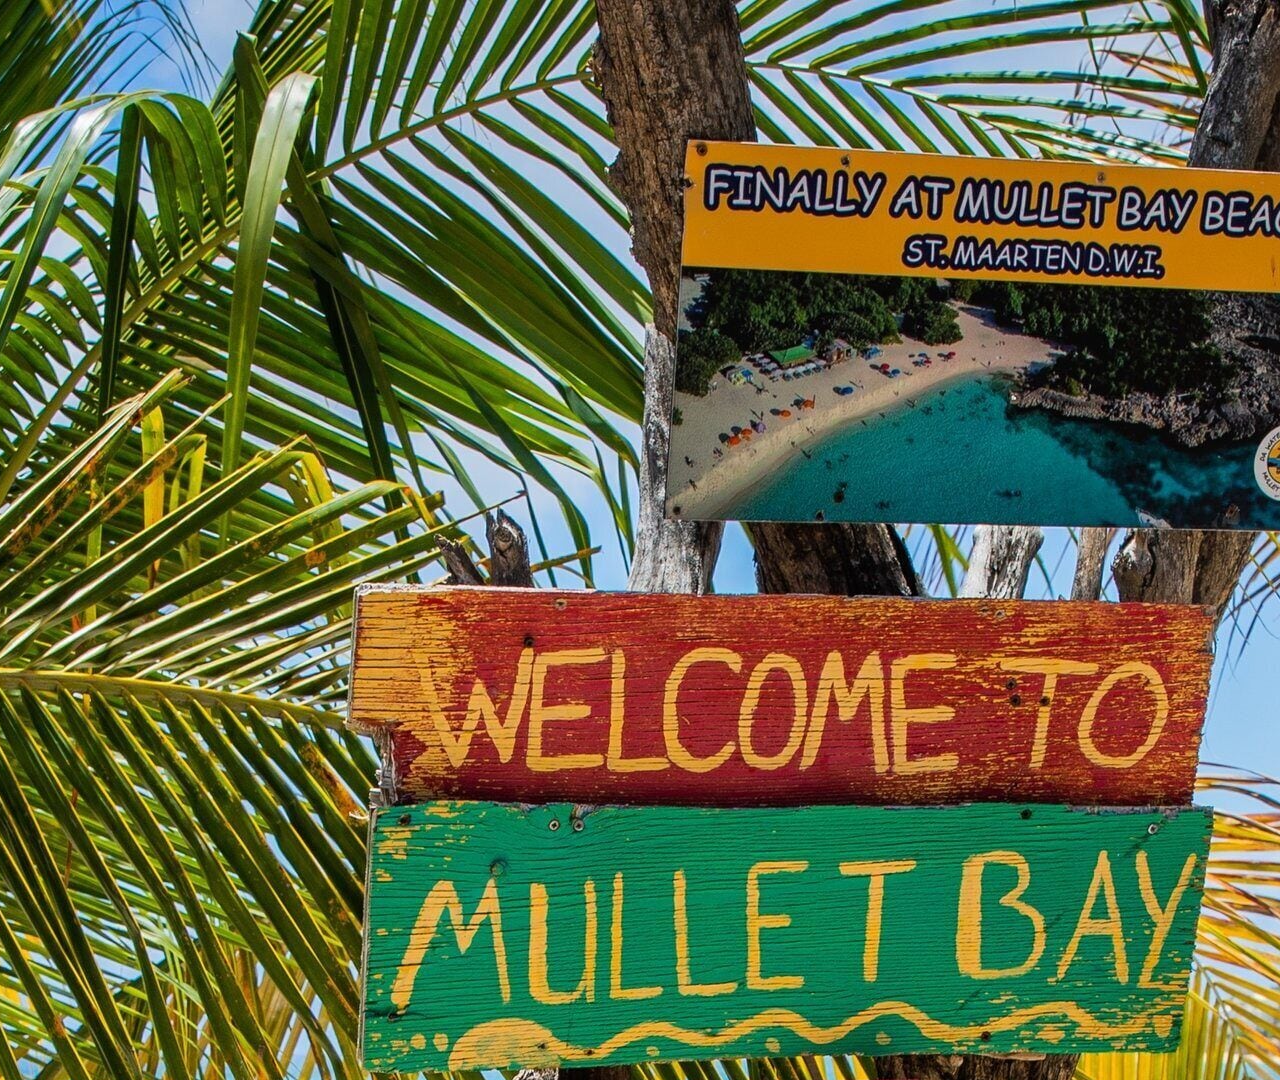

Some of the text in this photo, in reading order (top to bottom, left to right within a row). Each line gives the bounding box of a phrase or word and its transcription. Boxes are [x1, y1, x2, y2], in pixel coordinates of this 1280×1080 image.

[707, 167, 884, 215] FINALLY
[892, 179, 953, 217] AT
[956, 182, 1113, 226] MULLET
[1119, 190, 1195, 232] BAY
[905, 238, 1163, 276] ST. MAARTEN D.W.I.
[418, 646, 1169, 775] WELCOME TO
[390, 849, 1197, 1010] MULLET BAY
